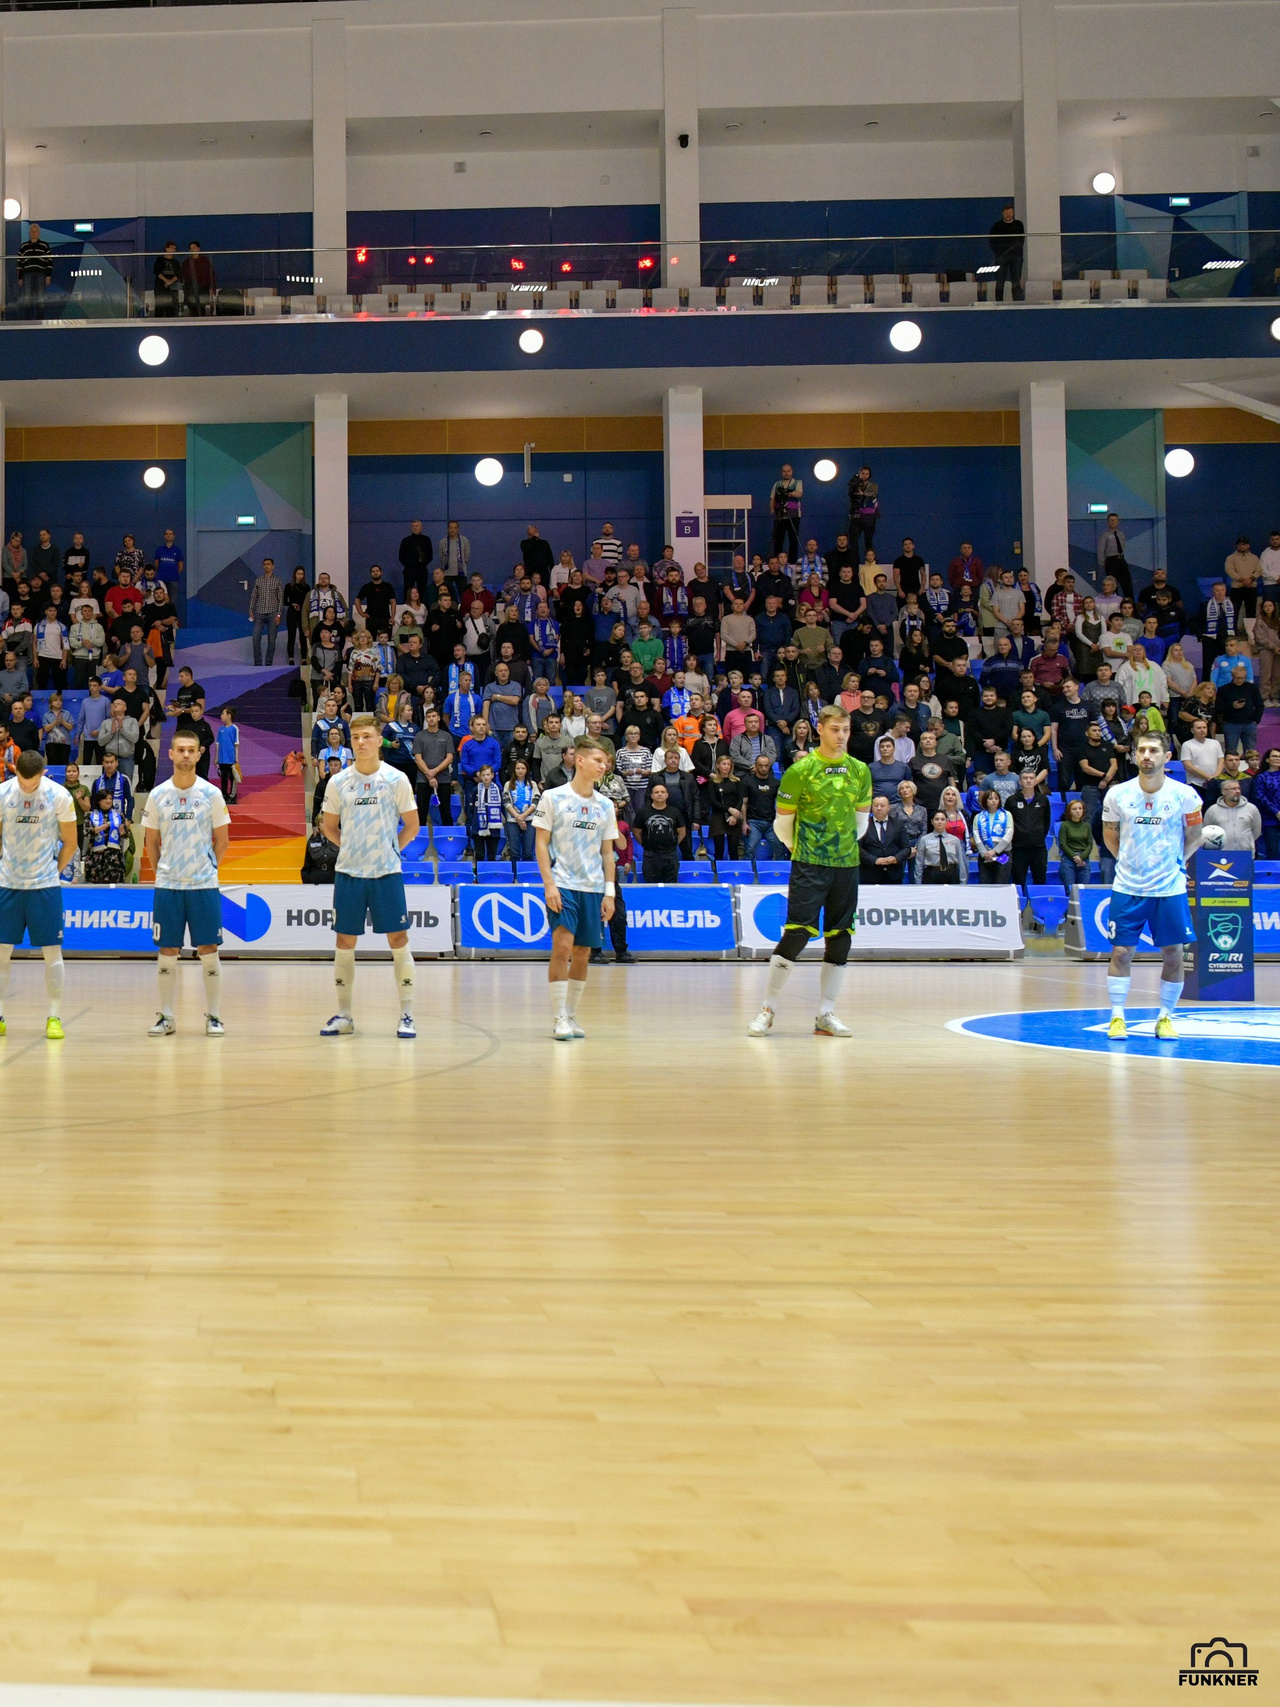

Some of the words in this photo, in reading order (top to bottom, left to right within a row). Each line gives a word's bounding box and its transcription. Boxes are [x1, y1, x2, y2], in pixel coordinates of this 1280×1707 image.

[355, 797, 378, 805] PARI
[172, 812, 195, 820] PARI
[573, 820, 596, 830] PARI
[1135, 817, 1161, 825] PARI
[64, 910, 153, 929] НИКЕЛ
[626, 909, 720, 928] НИКЕЛЬ
[855, 908, 1007, 927] НОРНИКЕЛЬ
[1209, 953, 1243, 961] PARI
